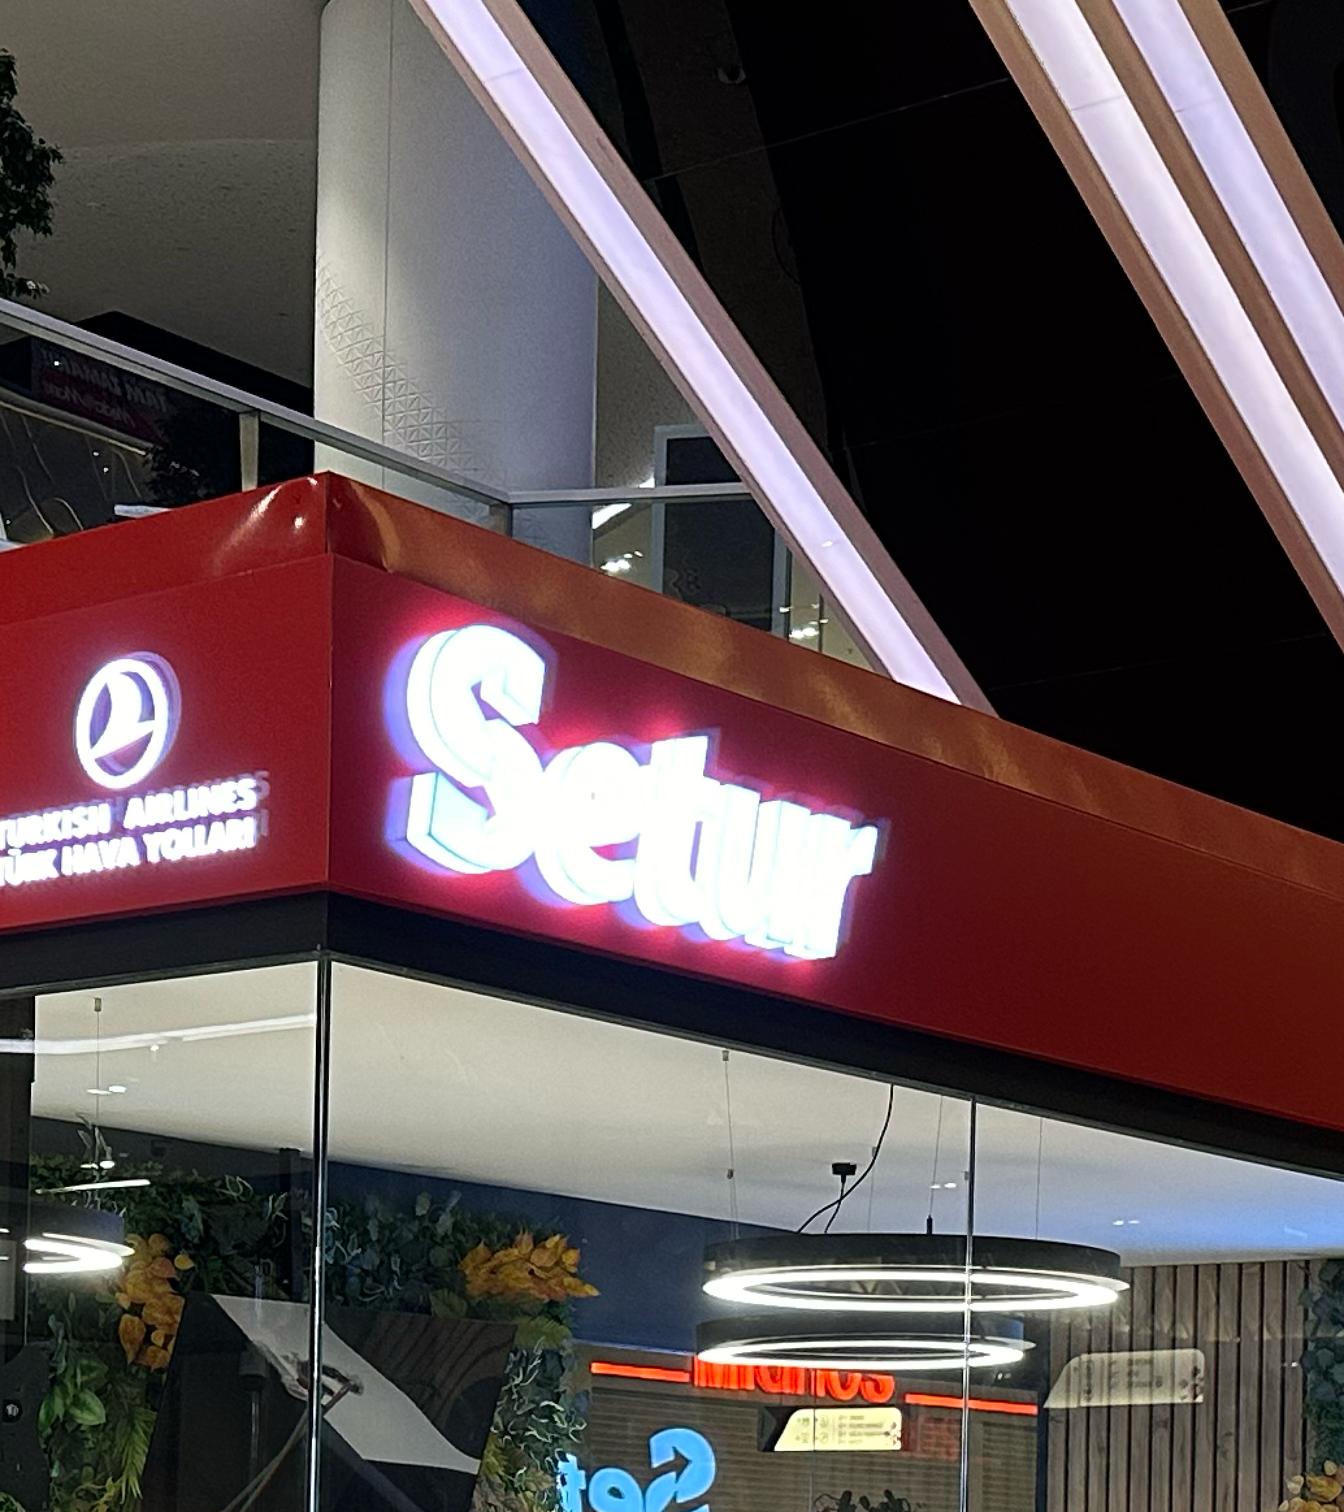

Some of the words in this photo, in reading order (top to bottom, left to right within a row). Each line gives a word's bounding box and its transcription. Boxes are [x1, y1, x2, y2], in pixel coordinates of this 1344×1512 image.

[123, 779, 258, 829] AIRLINES
[406, 625, 877, 959] Setur
[61, 837, 140, 875] HAVA
[143, 817, 258, 864] YOLLARI
